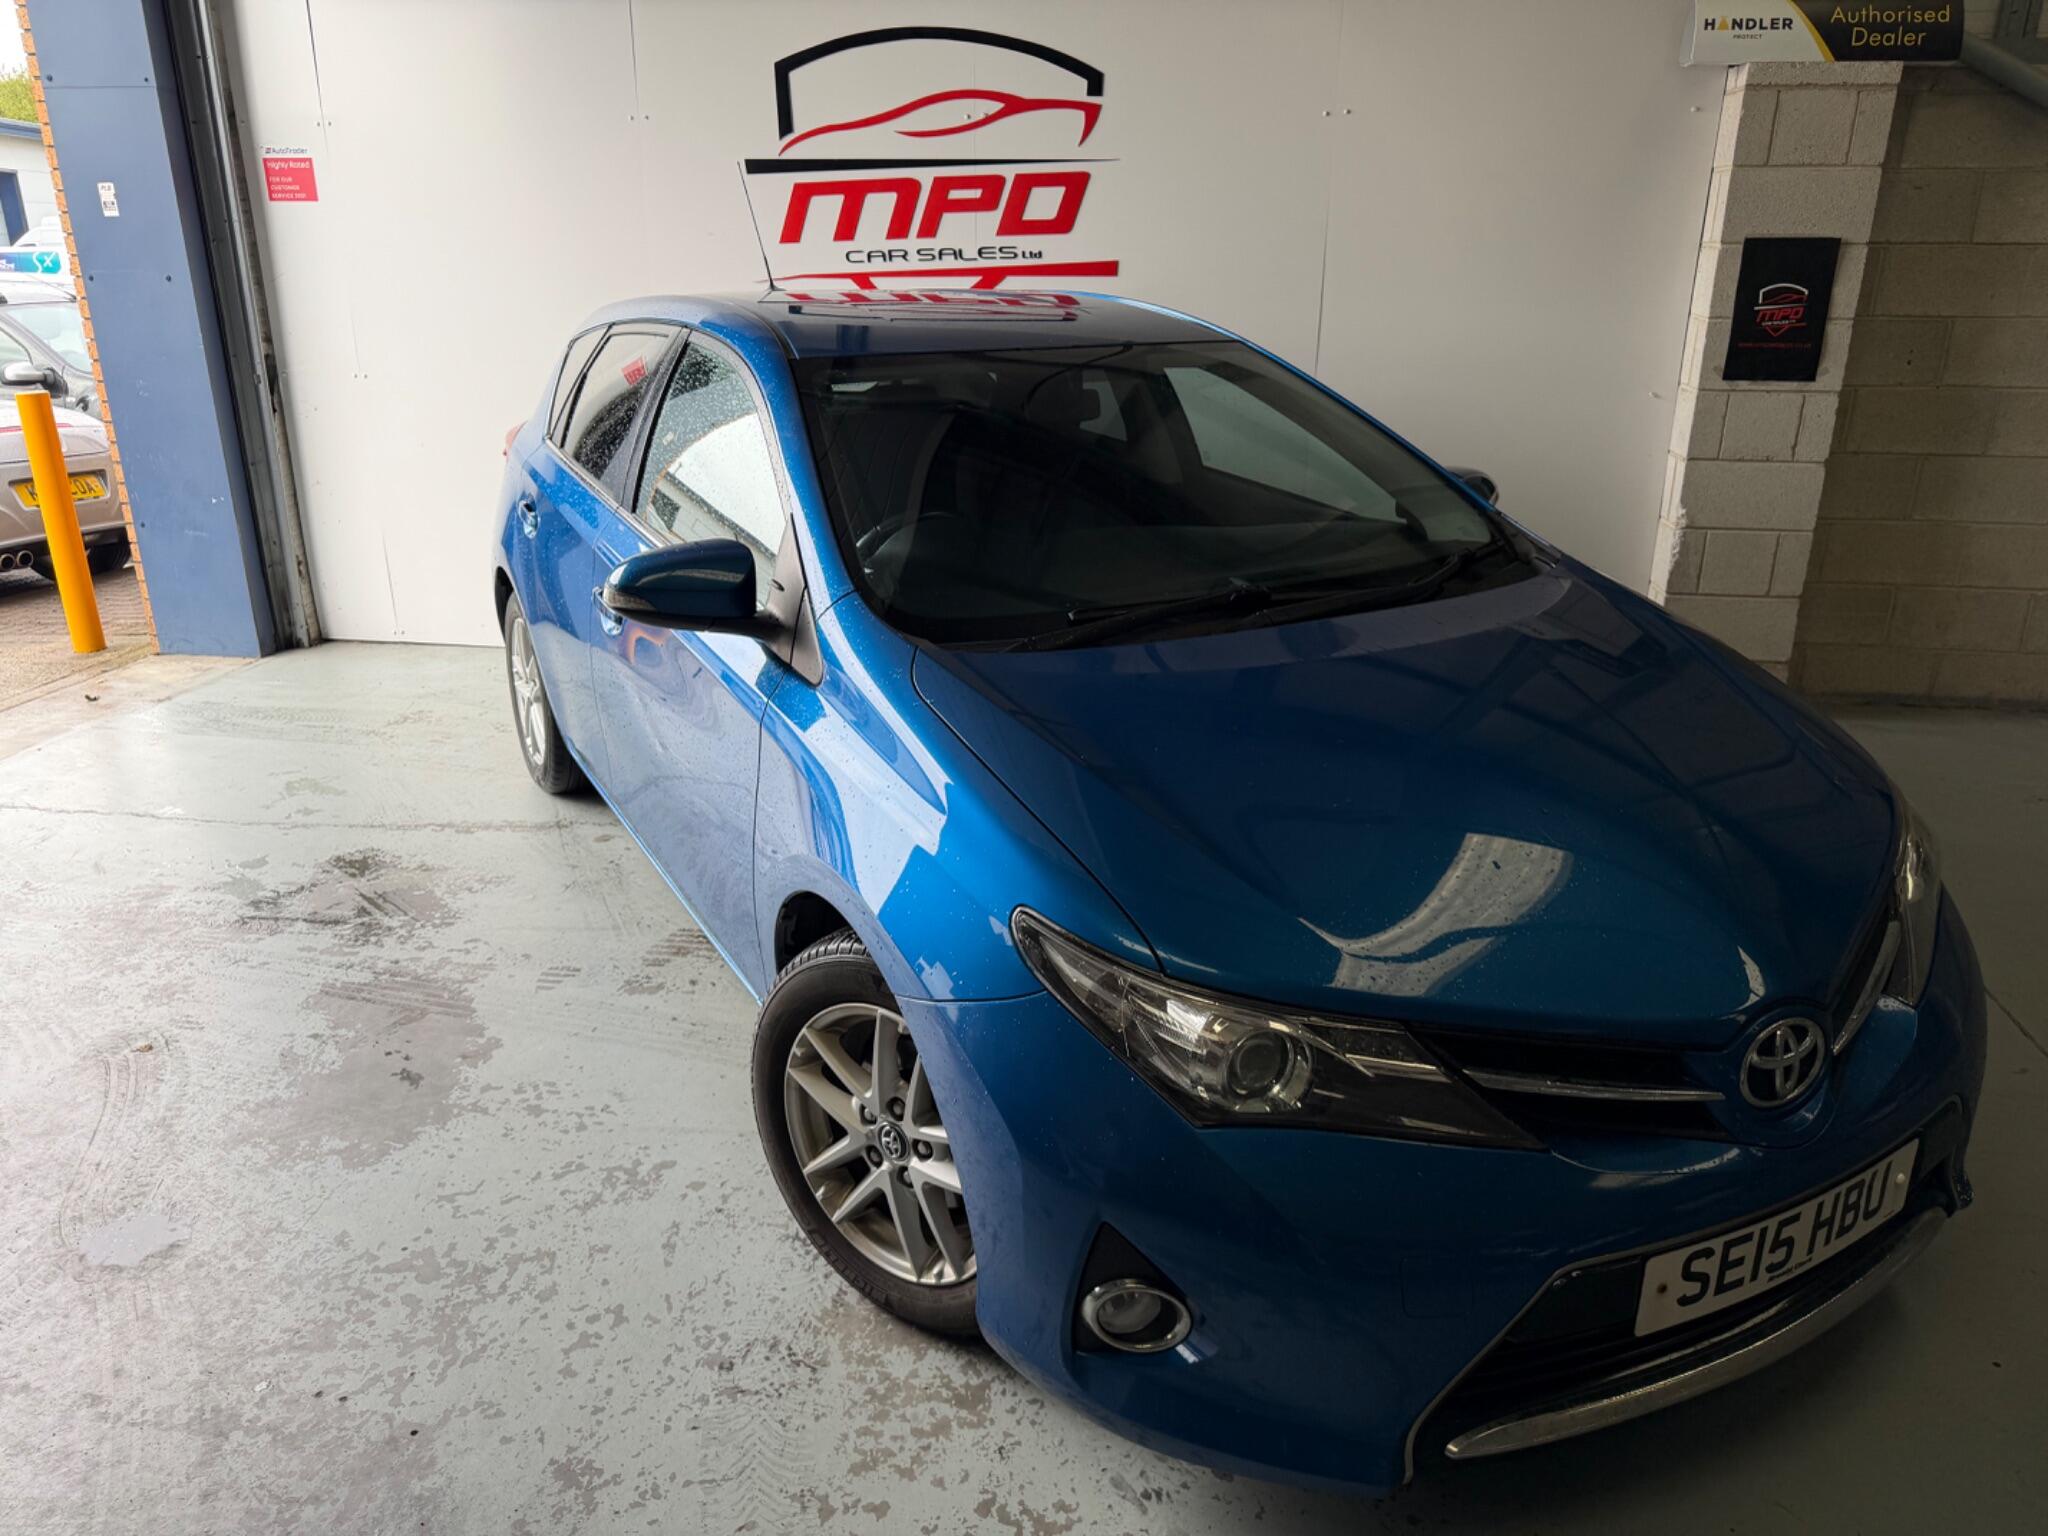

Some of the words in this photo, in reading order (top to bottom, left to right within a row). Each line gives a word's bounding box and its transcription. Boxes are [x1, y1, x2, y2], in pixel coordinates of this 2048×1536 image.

[1704, 16, 1794, 31] HANDLER
[1830, 4, 1951, 24] Authorised
[1851, 27, 1927, 47] Dealer
[845, 249, 909, 264] CAR
[916, 246, 1019, 262] SALES
[1022, 250, 1043, 260] Ltd
[1676, 1211, 1802, 1307] SE15
[1806, 1161, 1892, 1257] HBU
